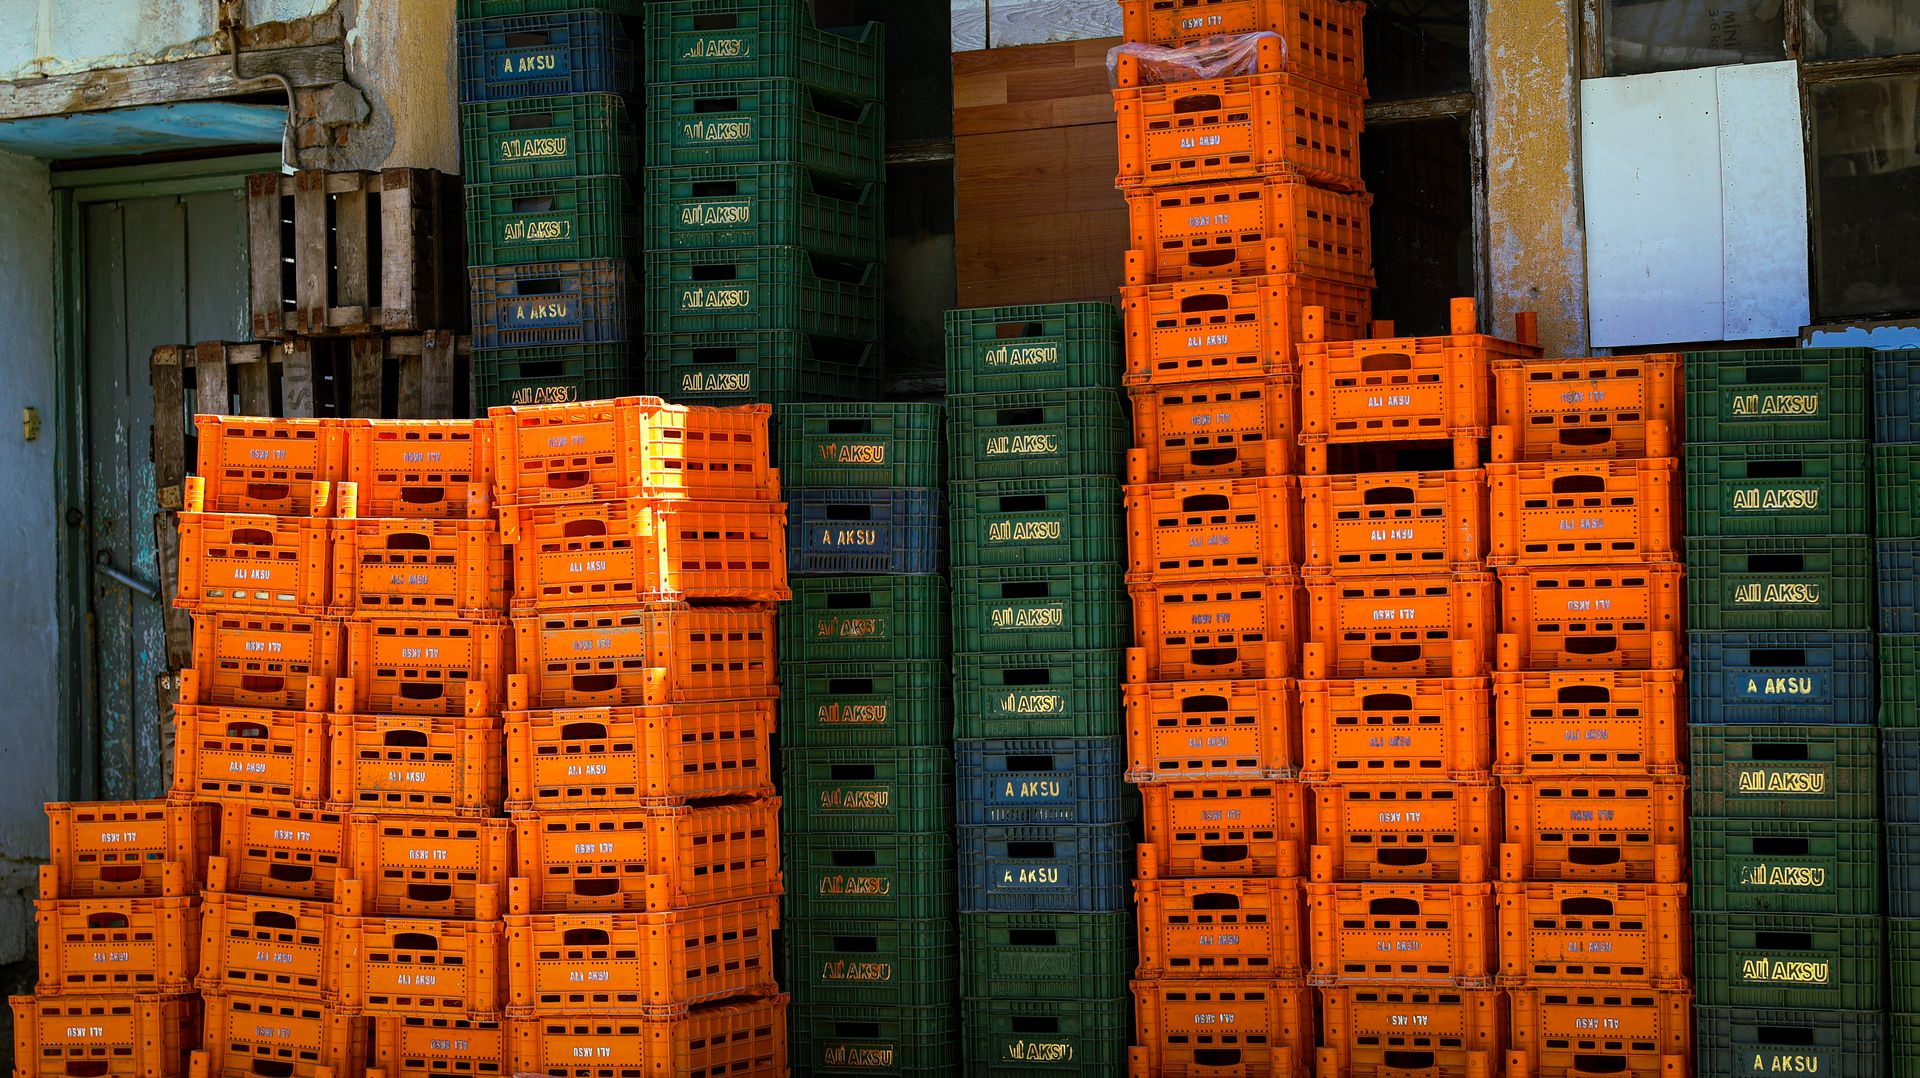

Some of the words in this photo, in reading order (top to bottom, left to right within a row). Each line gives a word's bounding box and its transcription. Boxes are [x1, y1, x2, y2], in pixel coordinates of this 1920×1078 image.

[519, 55, 555, 72] AKSU
[705, 122, 750, 140] AKSU
[522, 138, 566, 157] AKSU
[1181, 137, 1195, 148] ALI
[704, 206, 750, 224] AKSU
[705, 290, 750, 307] AKSU
[530, 302, 567, 319] AKSU
[1188, 336, 1202, 347] ALI
[1206, 334, 1228, 346] AKSU
[1010, 347, 1057, 365] AKSU
[705, 373, 750, 391] AKSU
[1368, 396, 1384, 407] ALI
[1388, 395, 1410, 407] AKSU
[1761, 395, 1818, 414] AKSU
[1008, 435, 1056, 453] AKSU
[838, 445, 884, 463] AKSU
[1762, 490, 1818, 509] AKSU
[1013, 521, 1060, 540] AKSU
[1371, 530, 1386, 541] ALI
[1391, 529, 1413, 540] AKSU
[837, 530, 876, 545] AKSU
[570, 562, 583, 572] ALI
[586, 561, 605, 572] AKSU
[234, 569, 247, 579] ALI
[251, 569, 270, 580] AKSU
[1763, 584, 1819, 602] AKSU
[1568, 600, 1590, 610] AKSU
[1595, 600, 1610, 610] ALI
[1015, 608, 1063, 626] AKSU
[1373, 610, 1395, 620] AKSU
[1400, 609, 1415, 619] ALI
[1764, 678, 1812, 694] AKSU
[841, 704, 887, 723] AKSU
[229, 762, 242, 773] ALI
[586, 764, 607, 775] AKSU
[406, 771, 426, 782] AKSU
[1768, 773, 1824, 792] AKSU
[1020, 781, 1060, 797] AKSU
[843, 790, 889, 808] AKSU
[1380, 812, 1401, 822] AKSU
[1406, 812, 1420, 822] ALI
[102, 833, 120, 842] AKSU
[124, 832, 136, 842] ALI
[274, 830, 293, 840] AKSU
[297, 832, 310, 841] ALI
[575, 844, 596, 854] AKSU
[599, 842, 614, 854] ALI
[410, 850, 429, 859] AKSU
[432, 850, 446, 860] ALI
[1019, 868, 1058, 883] AKSU
[1769, 867, 1824, 886] AKSU
[844, 877, 890, 894] AKSU
[846, 962, 891, 981] AKSU
[1771, 961, 1828, 982] AKSU
[398, 974, 411, 984] ALI
[1220, 1014, 1234, 1023] ALI
[1413, 1016, 1427, 1025] ALI
[1576, 1019, 1598, 1029] AKSU
[1604, 1019, 1618, 1028] ALI
[67, 1027, 86, 1037] AKSU
[90, 1027, 102, 1037] ALI
[573, 1047, 592, 1057] AKSU
[597, 1047, 610, 1057] ALI
[848, 1049, 893, 1066] AKSU
[1771, 1055, 1818, 1072] AKSU
